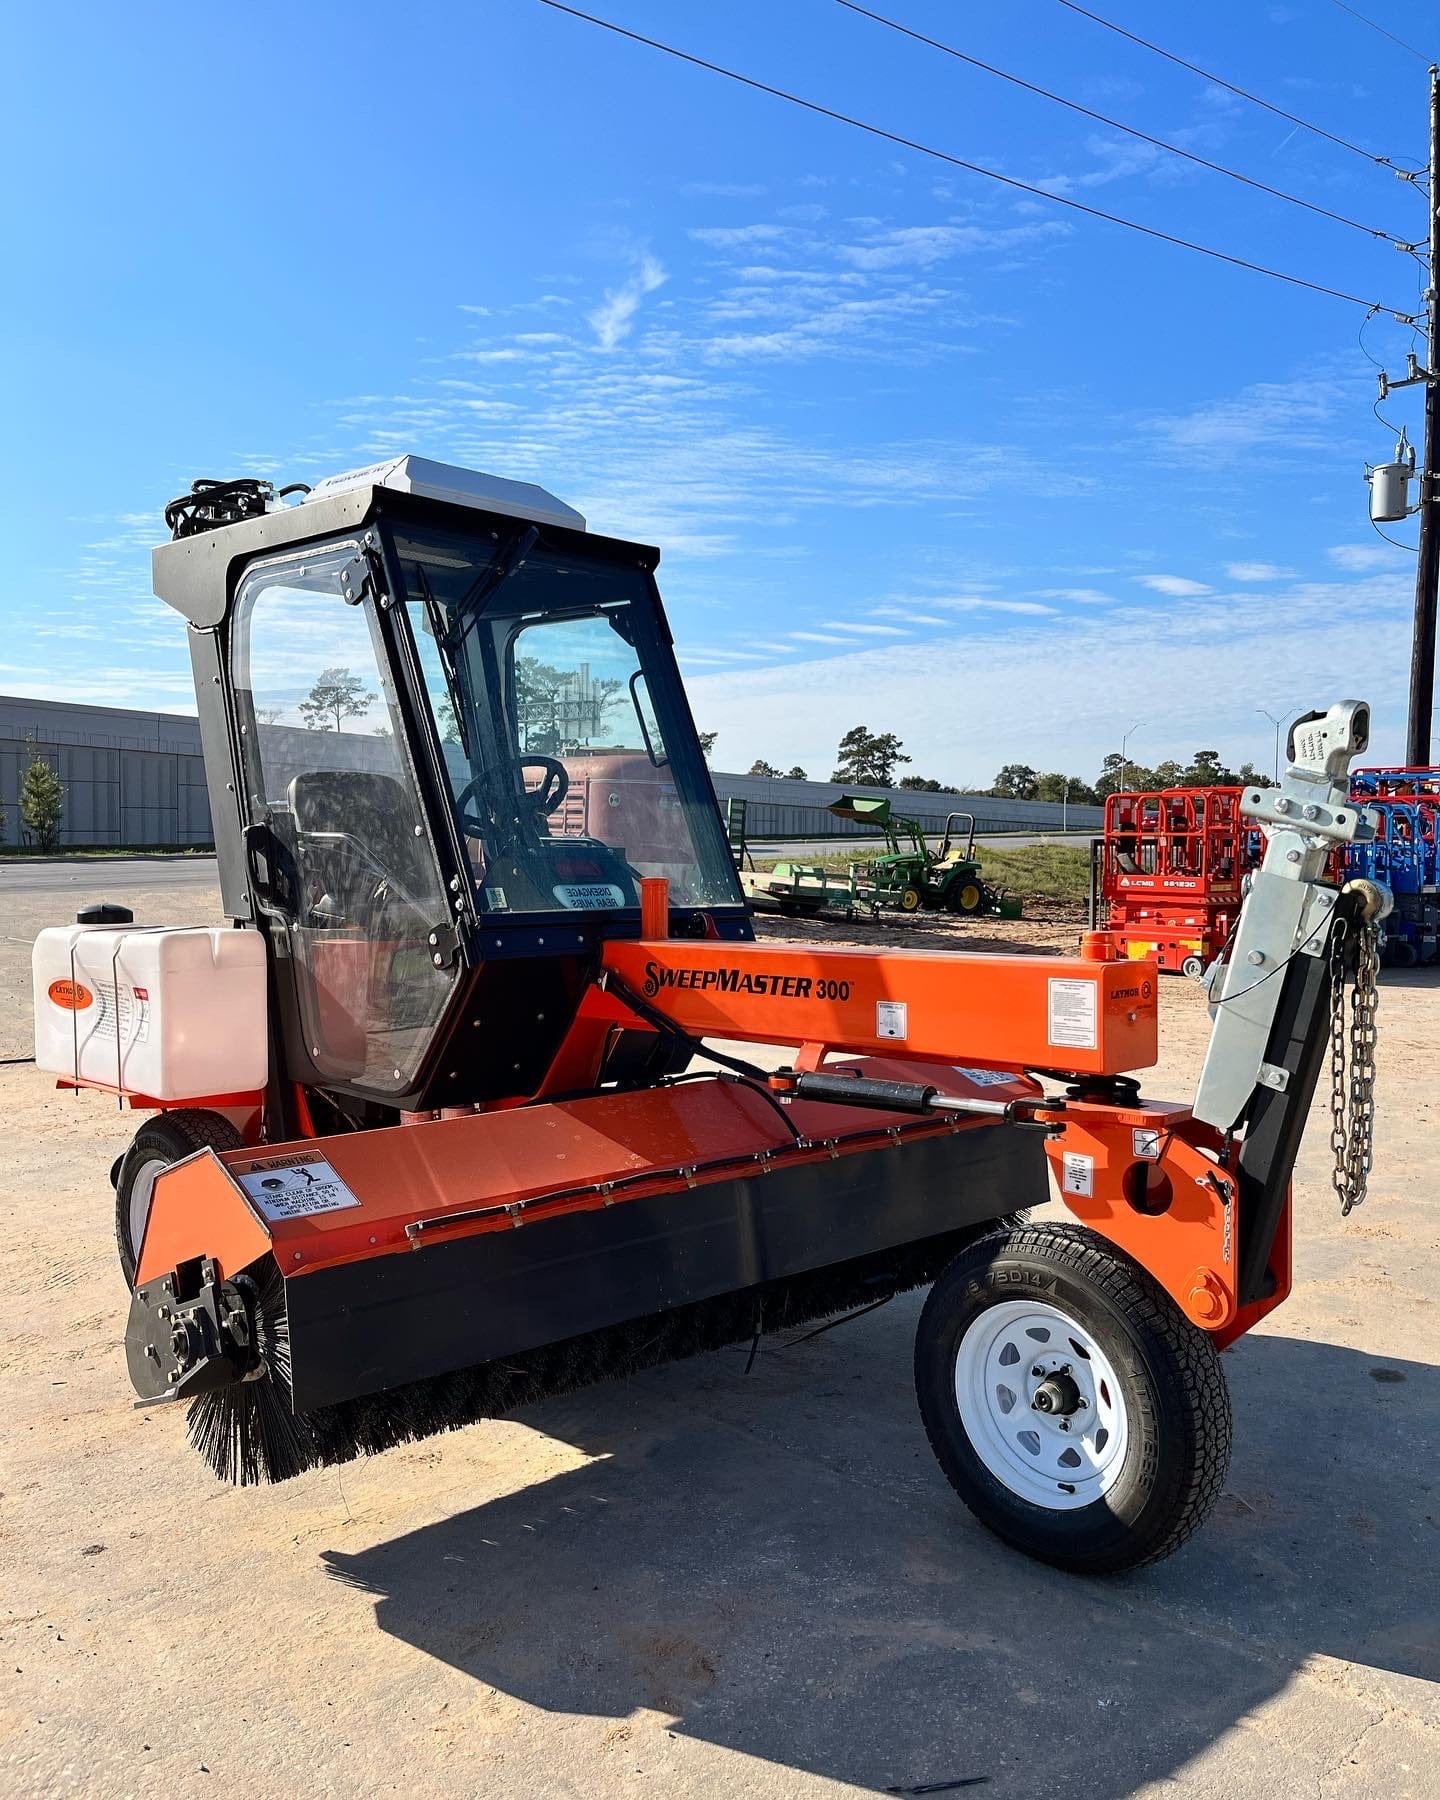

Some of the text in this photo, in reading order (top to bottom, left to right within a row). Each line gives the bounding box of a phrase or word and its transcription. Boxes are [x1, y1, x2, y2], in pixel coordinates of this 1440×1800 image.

[55, 986, 76, 996] LAYMO
[1110, 987, 1139, 1000] LAYMOR
[267, 1154, 314, 1168] WARNING
[264, 1196, 290, 1204] MINIMUM
[292, 1191, 319, 1200] DISTANCE
[291, 1196, 315, 1204] MACHINE
[287, 1201, 320, 1209] OPERATION
[280, 1208, 300, 1216] ENGINE
